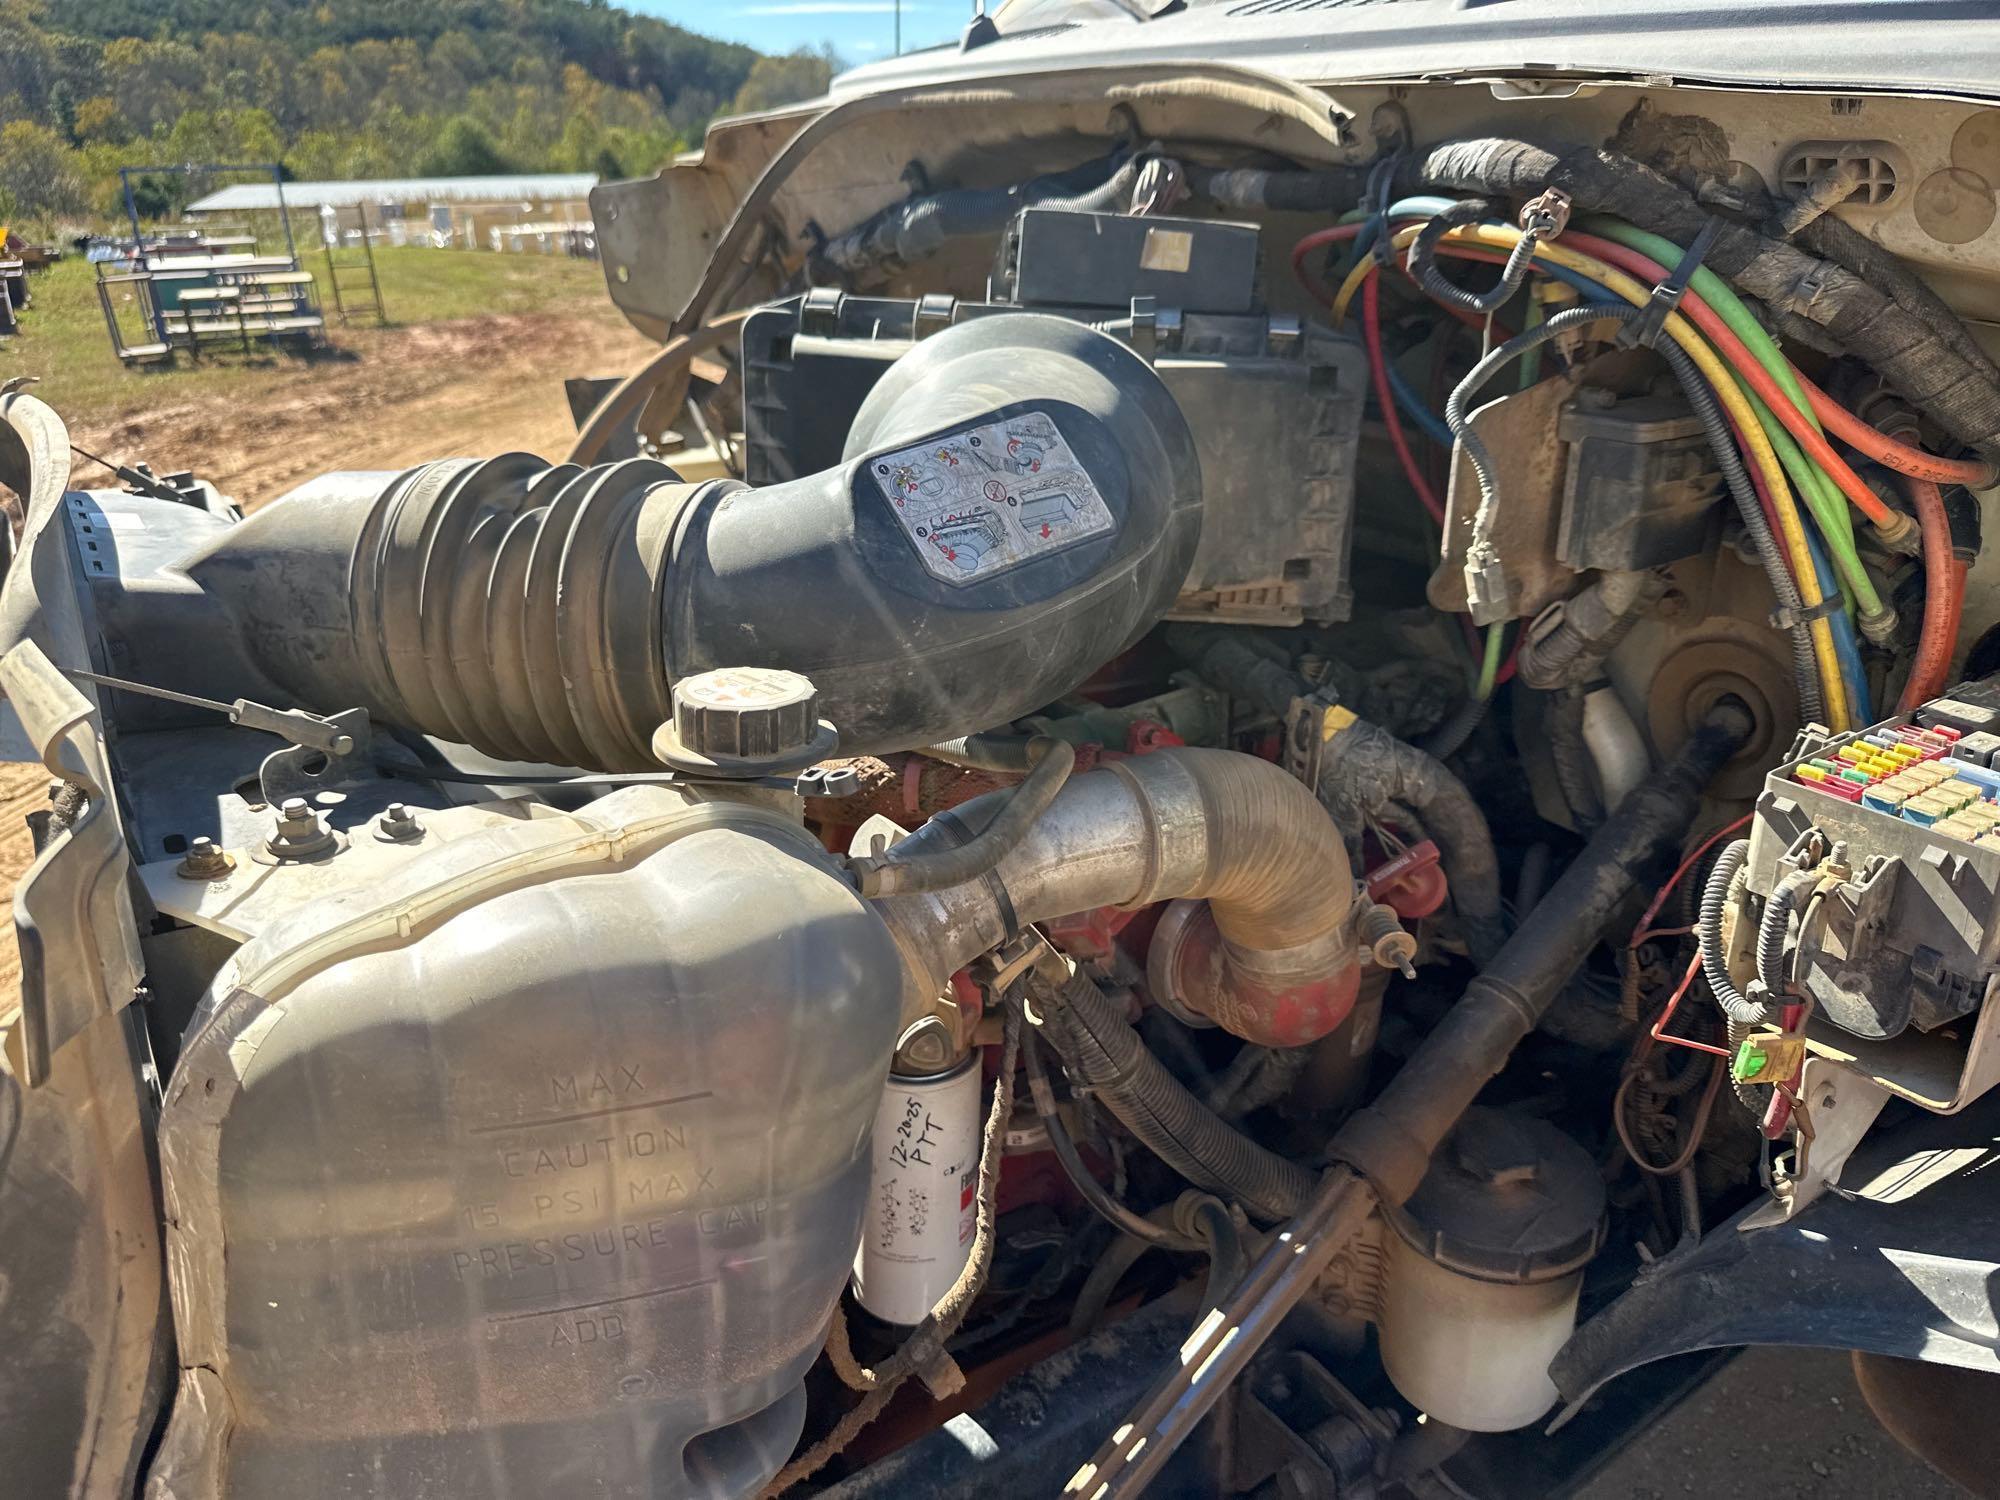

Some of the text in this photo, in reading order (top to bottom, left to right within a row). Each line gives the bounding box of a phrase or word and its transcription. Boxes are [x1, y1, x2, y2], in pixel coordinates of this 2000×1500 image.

[552, 1064, 646, 1103] MAX
[504, 1126, 687, 1178] CAUTION
[463, 1167, 717, 1232] 15 PSI MAX
[453, 1200, 770, 1280] PRESSURE CAP
[551, 1315, 625, 1349] ADD
